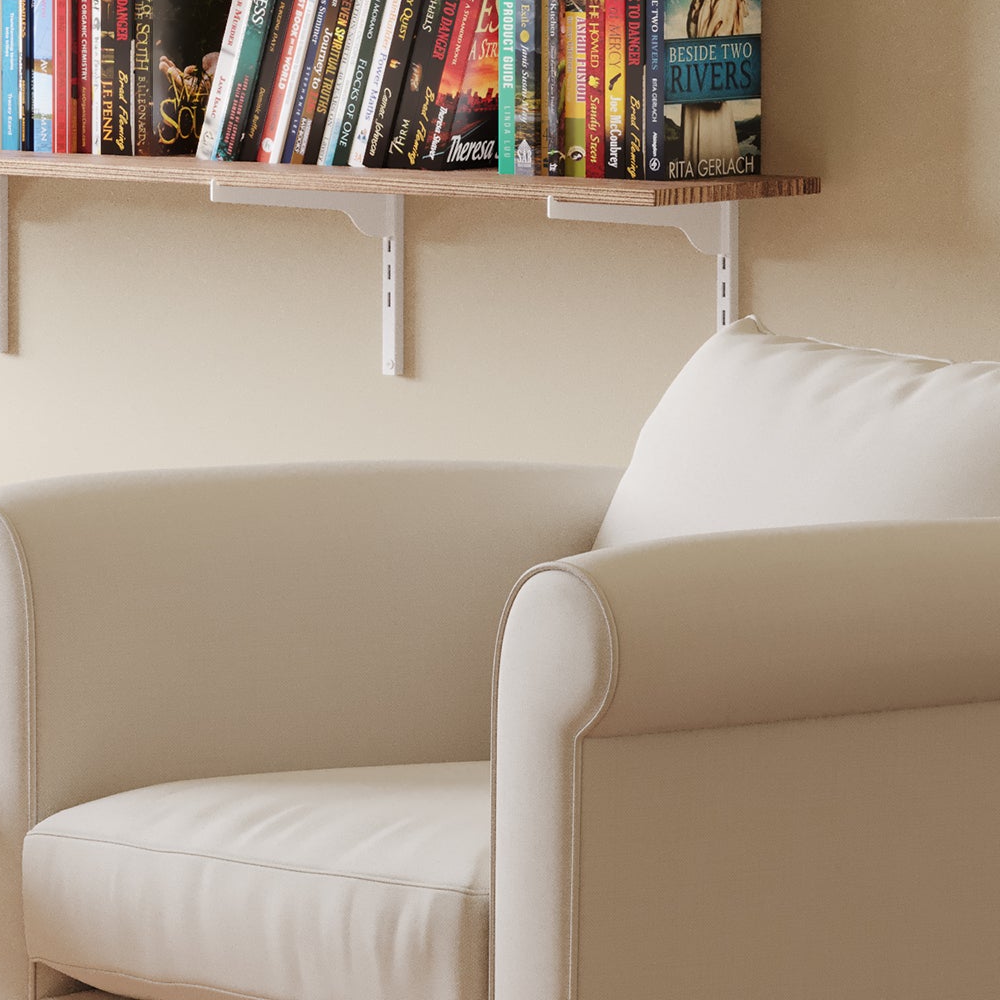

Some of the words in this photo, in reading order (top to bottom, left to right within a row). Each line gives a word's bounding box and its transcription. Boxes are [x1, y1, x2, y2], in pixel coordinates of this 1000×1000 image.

[395, 7, 415, 41] QUEST
[135, 22, 149, 71] SOUTH
[324, 27, 347, 77] SPIRITUAL
[590, 23, 599, 68] HOWLED
[608, 24, 622, 69] MERCY
[669, 44, 717, 62] BESIDE
[721, 42, 753, 59] TWO
[670, 59, 751, 92] RIVERS
[314, 77, 334, 114] TRUTHS
[589, 95, 600, 131] Sandy
[608, 95, 622, 114] Joe
[447, 134, 494, 163] Theresa
[589, 134, 600, 163] Steen
[608, 115, 622, 168] McCoubrey
[669, 159, 694, 179] RITA
[698, 155, 754, 176] GERLACH
